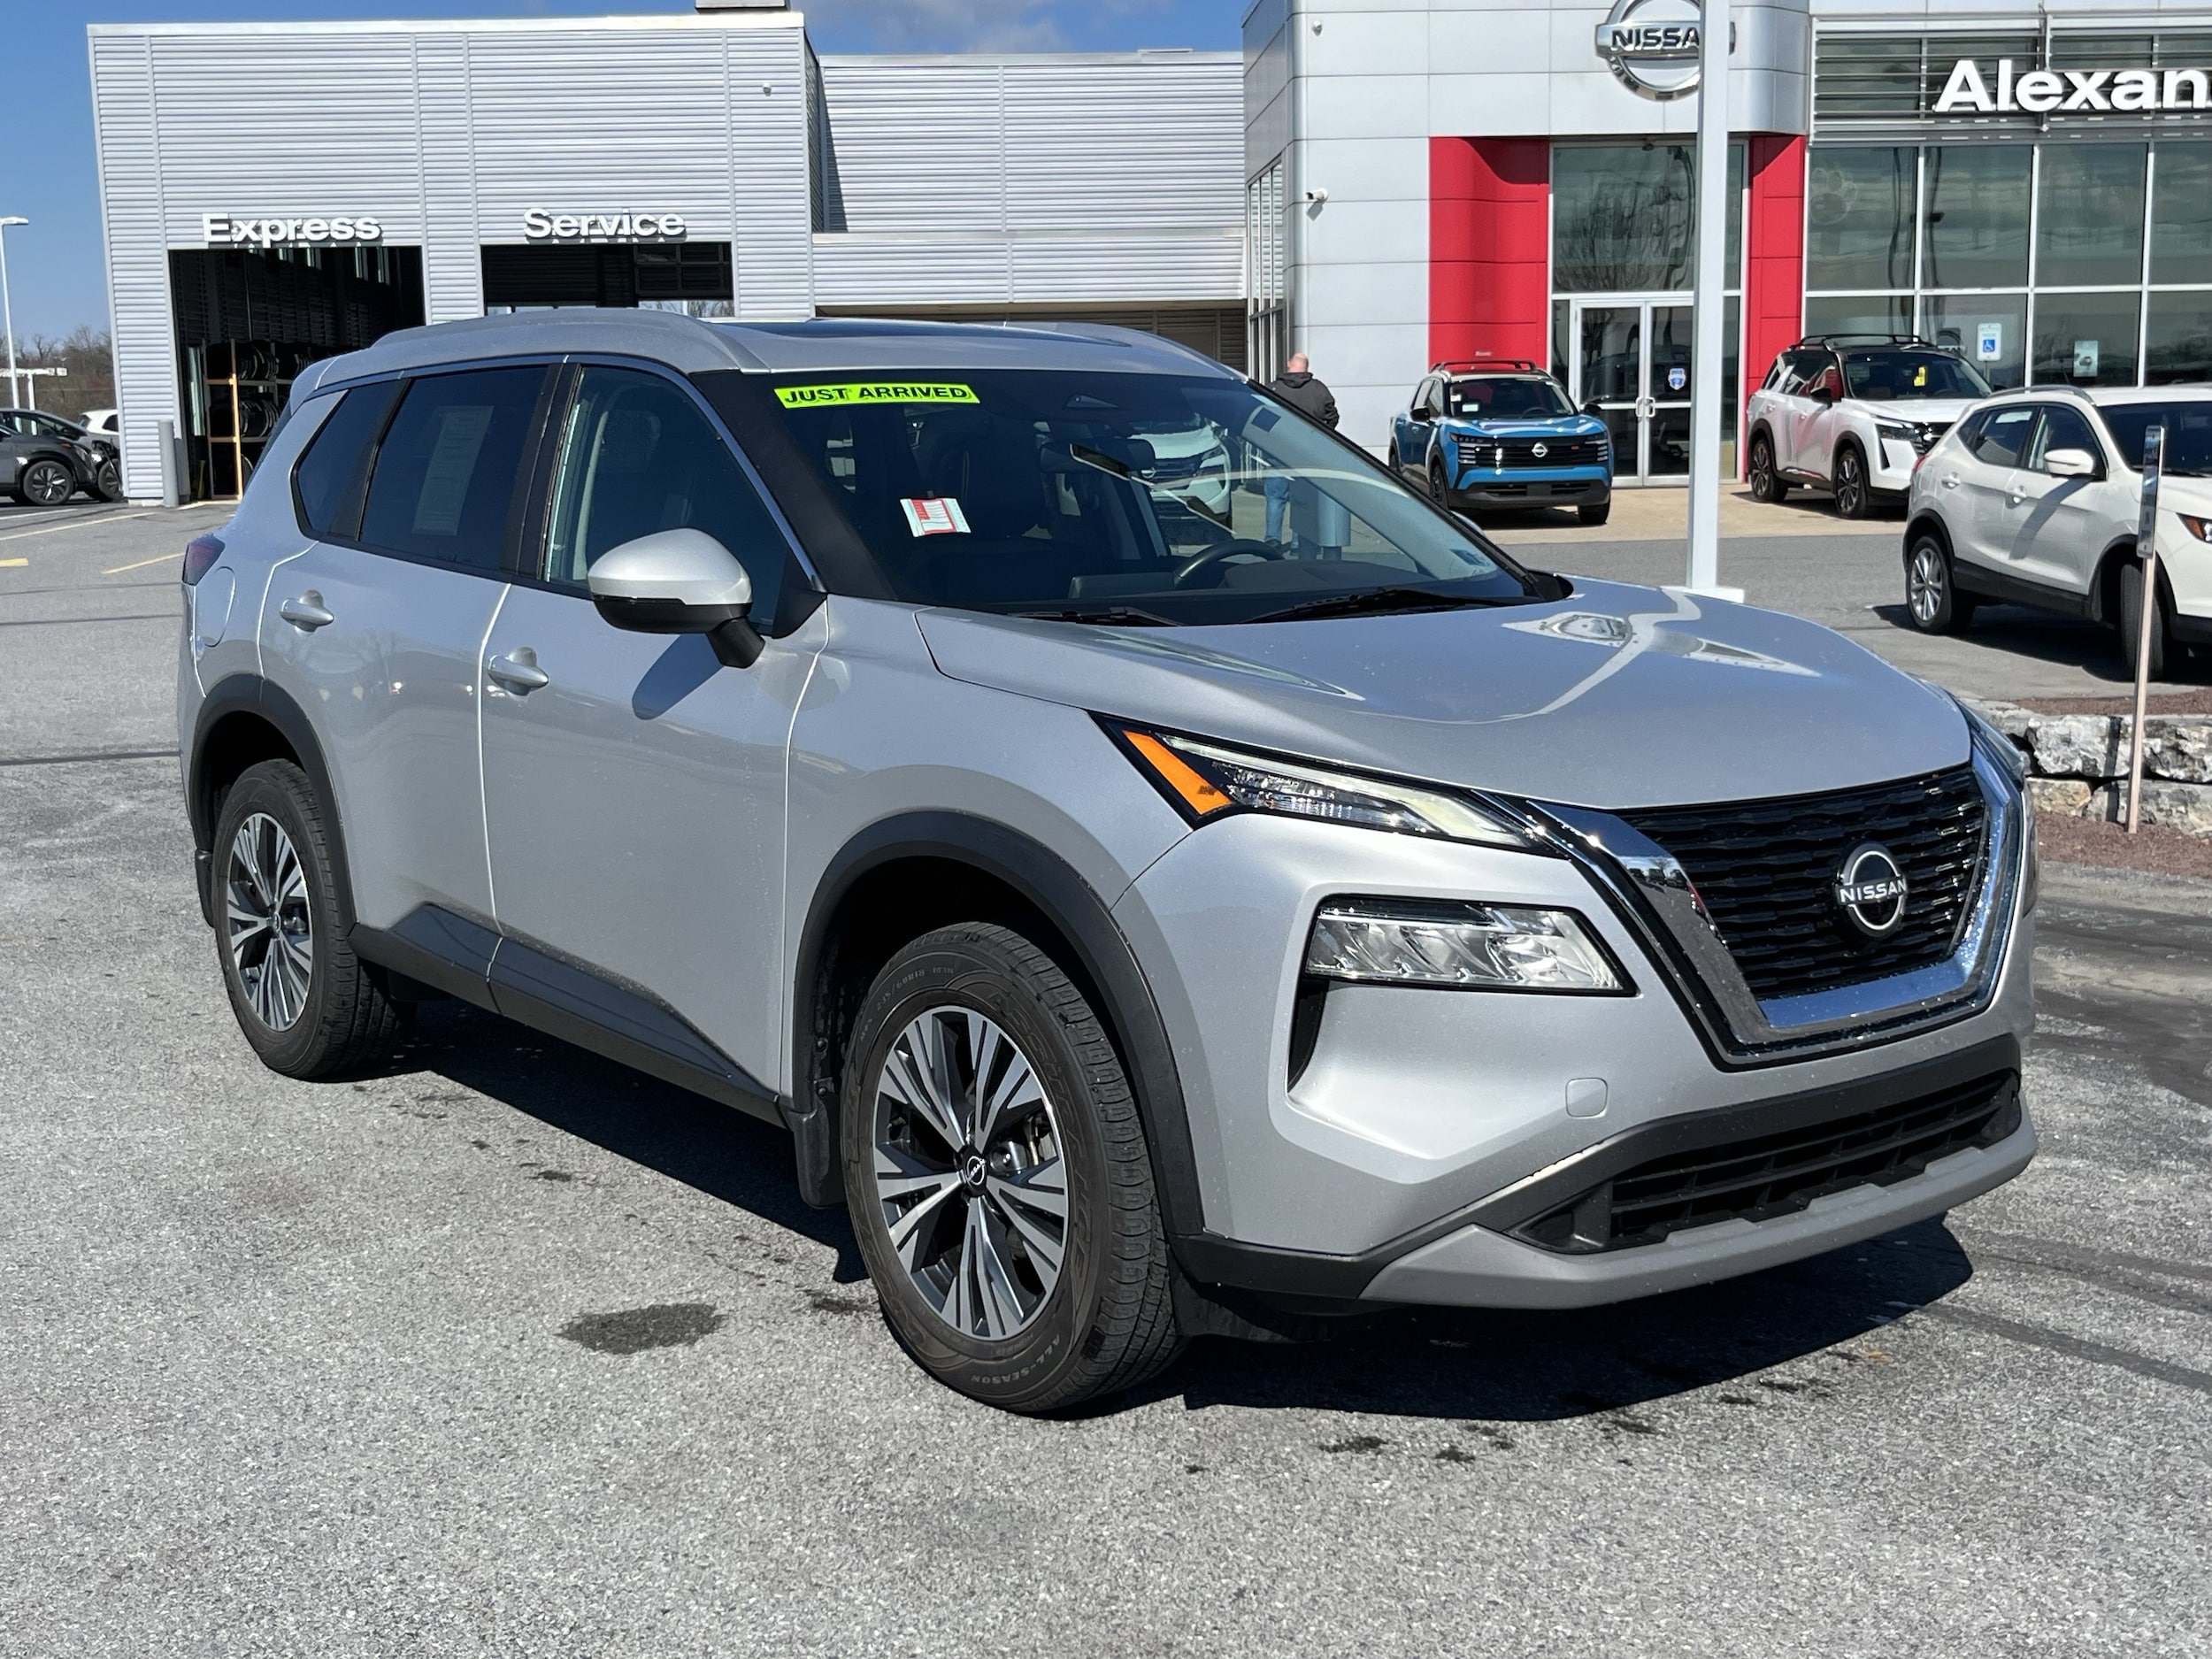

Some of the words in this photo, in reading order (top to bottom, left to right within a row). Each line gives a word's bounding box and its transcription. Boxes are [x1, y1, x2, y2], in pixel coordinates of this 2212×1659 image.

[1611, 27, 1700, 49] NISSA
[1934, 59, 2208, 112] Alexan
[202, 212, 381, 248] Express
[524, 208, 686, 238] Service
[785, 388, 847, 403] JUST
[859, 387, 967, 398] ARRIVED
[1839, 879, 1906, 902] NISSAN
[971, 1333, 1060, 1385] ALL-SEASON
